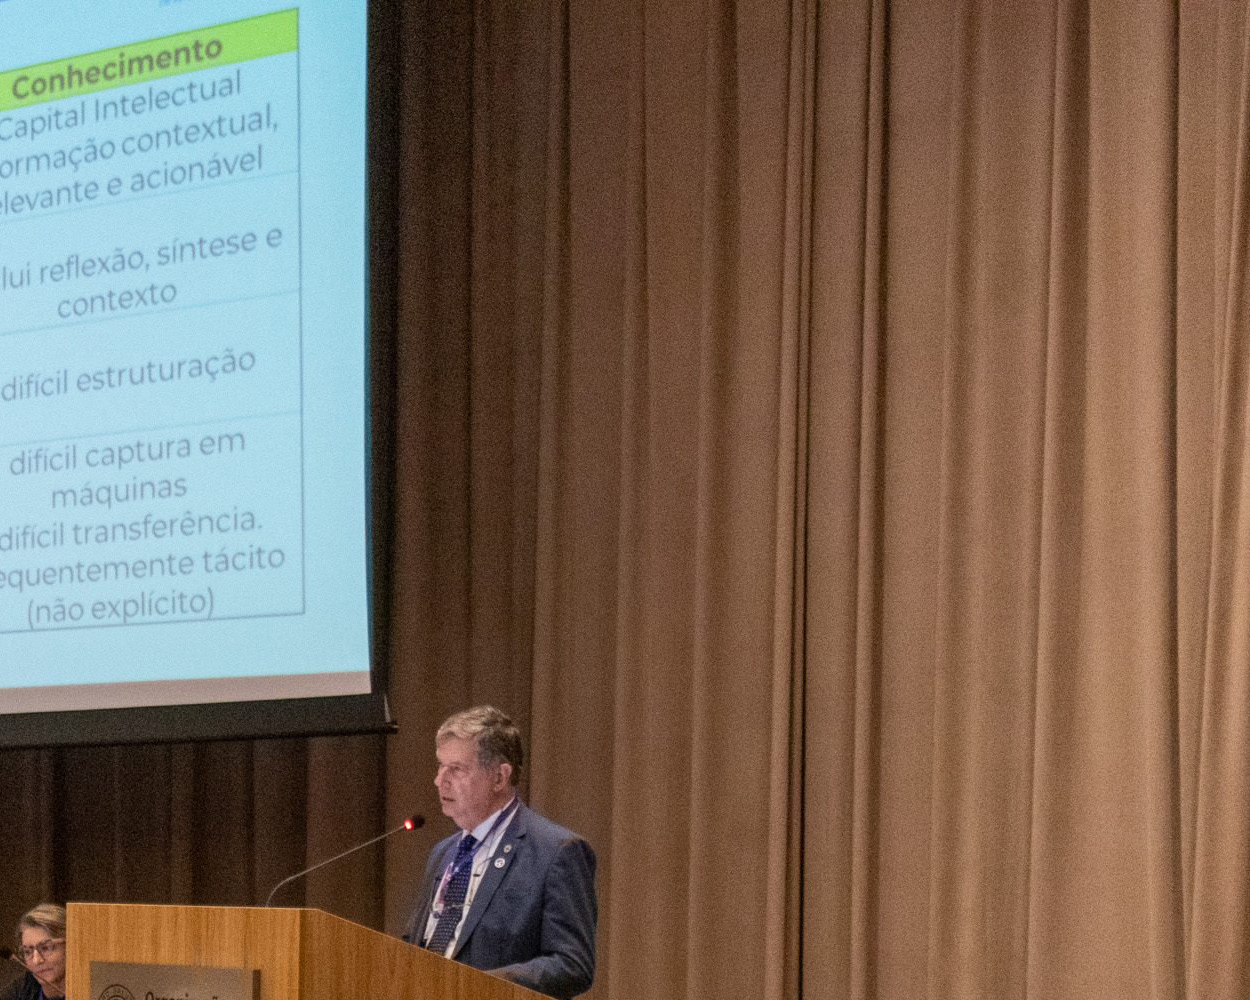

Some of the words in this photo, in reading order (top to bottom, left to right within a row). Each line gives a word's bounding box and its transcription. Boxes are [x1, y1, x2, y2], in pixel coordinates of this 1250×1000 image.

[12, 36, 223, 100] Conhecimento
[94, 70, 241, 122] Intelectual
[122, 104, 278, 156] contextual,
[108, 176, 122, 197] e
[130, 145, 263, 193] acionável
[40, 246, 150, 285] reflexão,
[157, 227, 257, 266] síntese
[267, 227, 282, 248] e
[57, 282, 177, 319] contexto
[1, 370, 68, 402] difícil
[76, 349, 255, 393] estruturação
[10, 445, 77, 476] difícil
[85, 434, 192, 471] captura
[199, 430, 245, 454] em
[52, 478, 187, 510] máquinas
[73, 508, 262, 546] transferência.
[202, 545, 285, 572] tácito
[28, 598, 84, 630] (não
[91, 587, 214, 624] explícito)
